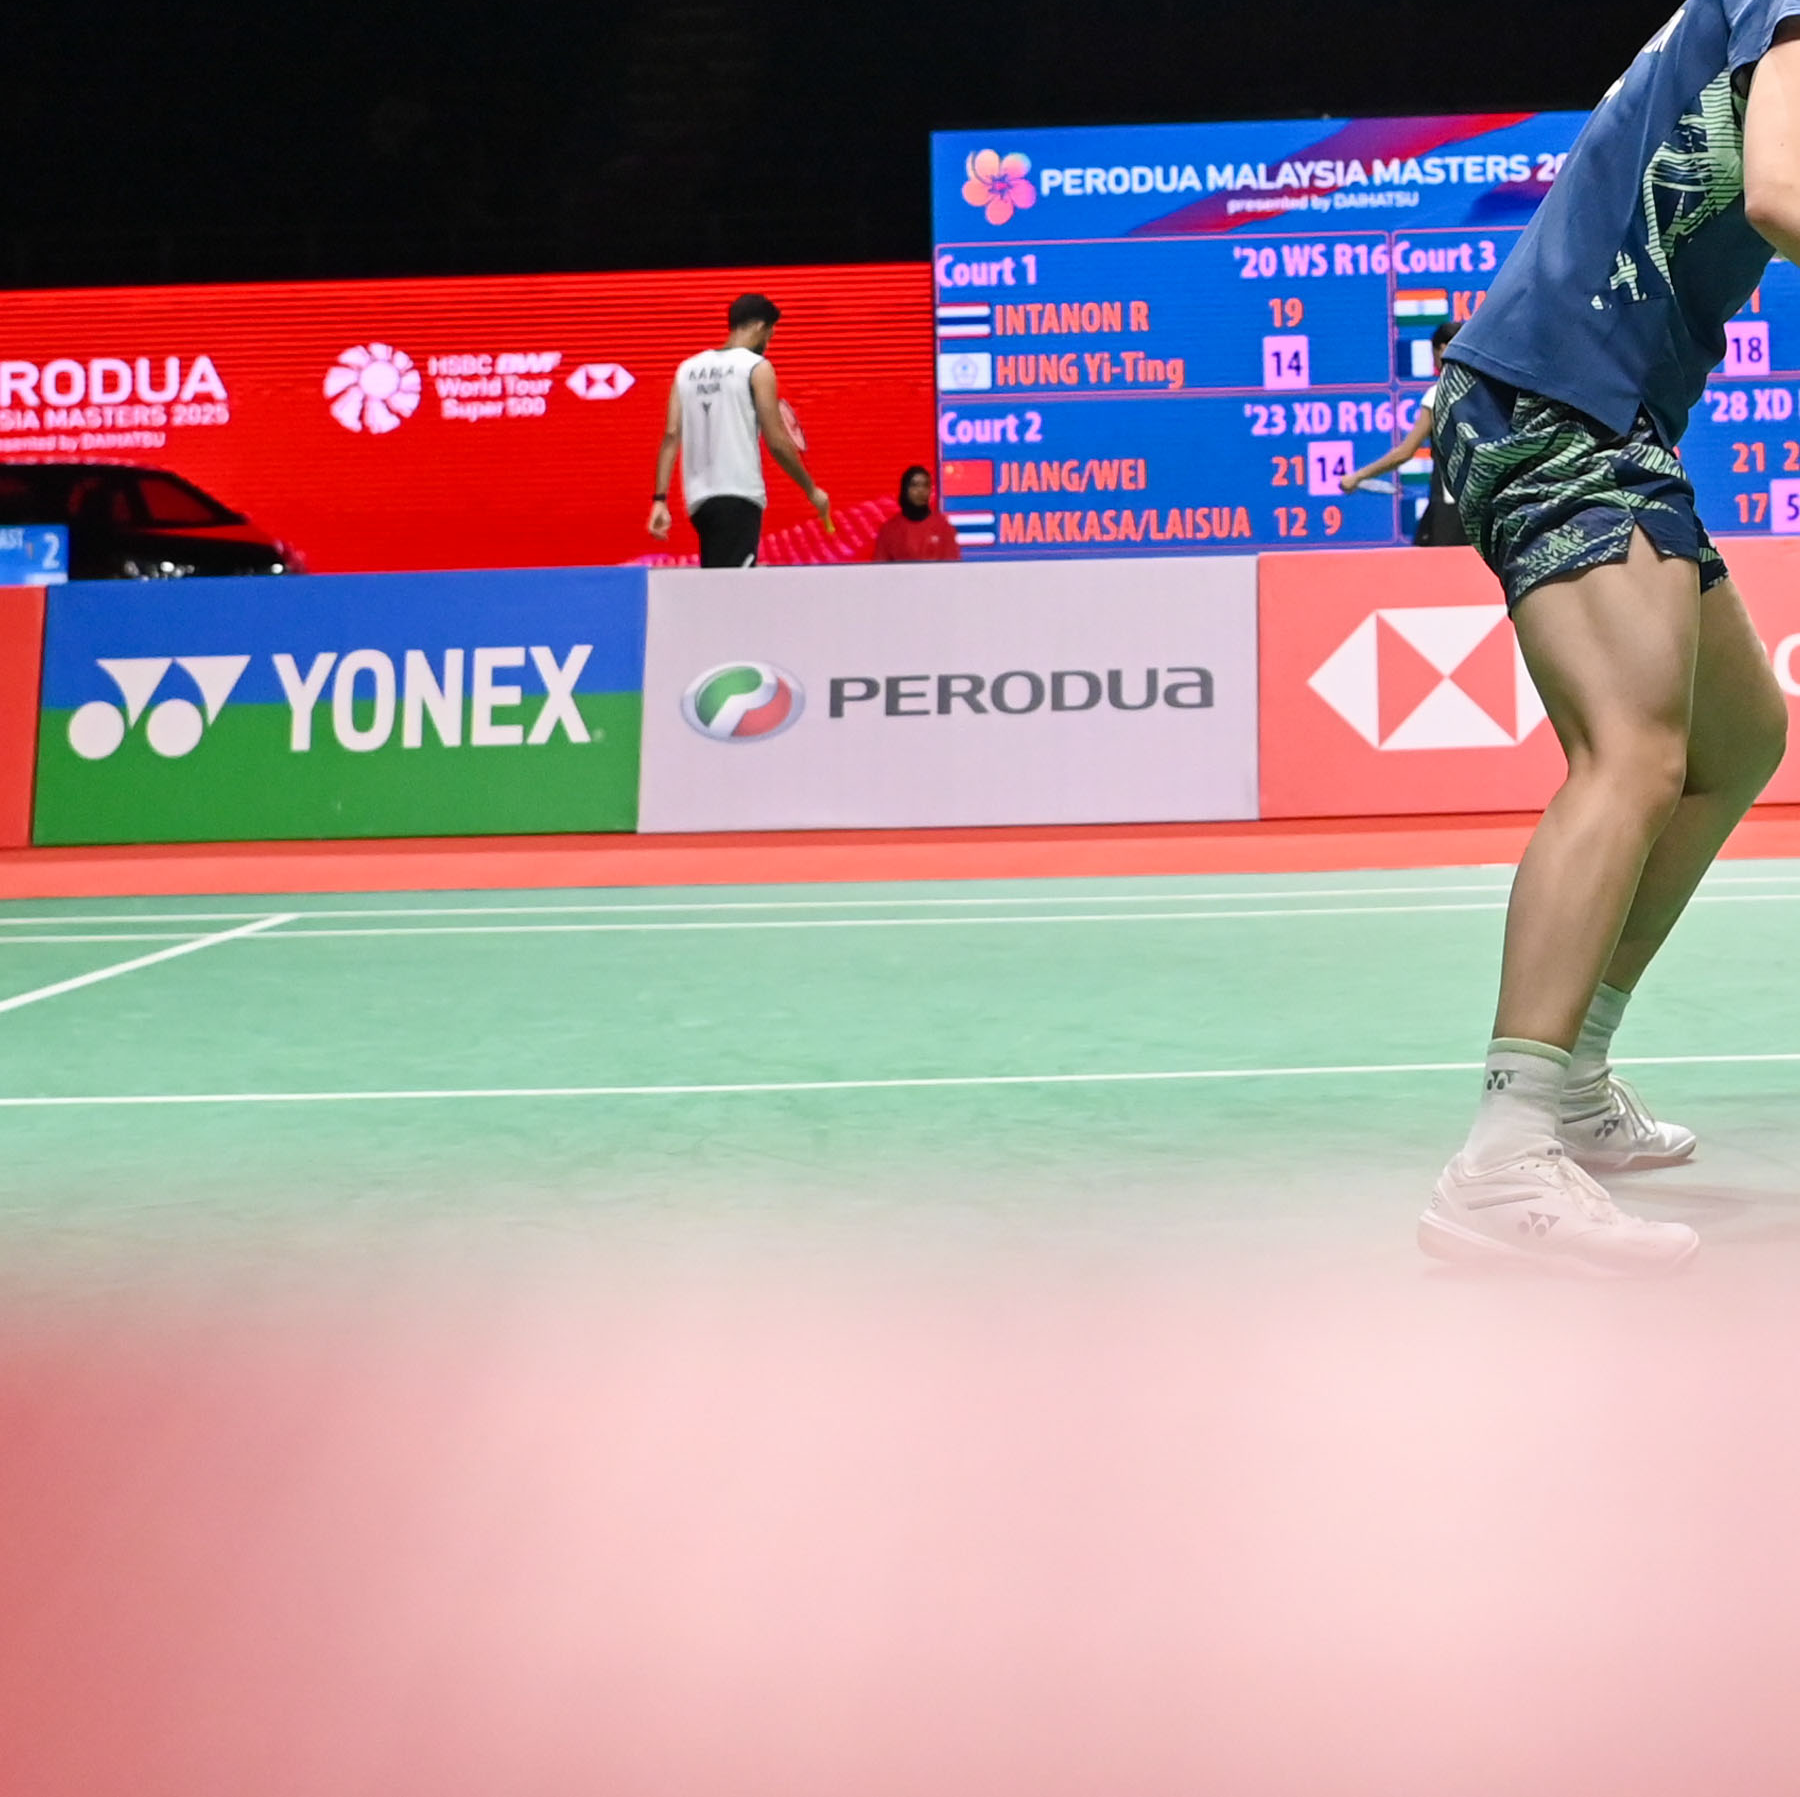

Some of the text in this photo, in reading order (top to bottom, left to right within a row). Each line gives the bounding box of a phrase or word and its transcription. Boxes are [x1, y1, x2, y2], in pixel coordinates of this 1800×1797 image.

[1041, 164, 1202, 196] PERODUA
[1206, 159, 1369, 192] MALAYSIA
[1372, 153, 1532, 186] MASTERS
[937, 254, 1037, 287] Court 1
[1233, 243, 1390, 278] '20 WS R16
[1393, 240, 1497, 274] Court 3
[995, 300, 1150, 335] INTANON R
[1269, 297, 1304, 328] 19
[1271, 350, 1303, 377] 14
[1732, 337, 1763, 363] 18
[435, 375, 553, 397] World Tour
[996, 351, 1185, 390] HUNG Yi-Ting
[44, 405, 168, 430] MASTERS
[171, 402, 230, 426] 2025
[440, 398, 504, 423] Super
[1292, 401, 1332, 435] XD
[1338, 400, 1394, 433] R16
[1704, 390, 1749, 422] '28
[1752, 388, 1793, 421] XD
[938, 411, 1043, 444] Court 2
[1271, 455, 1347, 486] 21 14
[1732, 440, 1800, 473] 21 2
[997, 458, 1147, 494] JIANG/WEI
[999, 506, 1252, 543] MAKKASA/LAISUA
[1274, 505, 1343, 537] 12 9
[1735, 492, 1800, 524] 17 5
[42, 532, 60, 570] 2
[272, 644, 593, 753] YONEX
